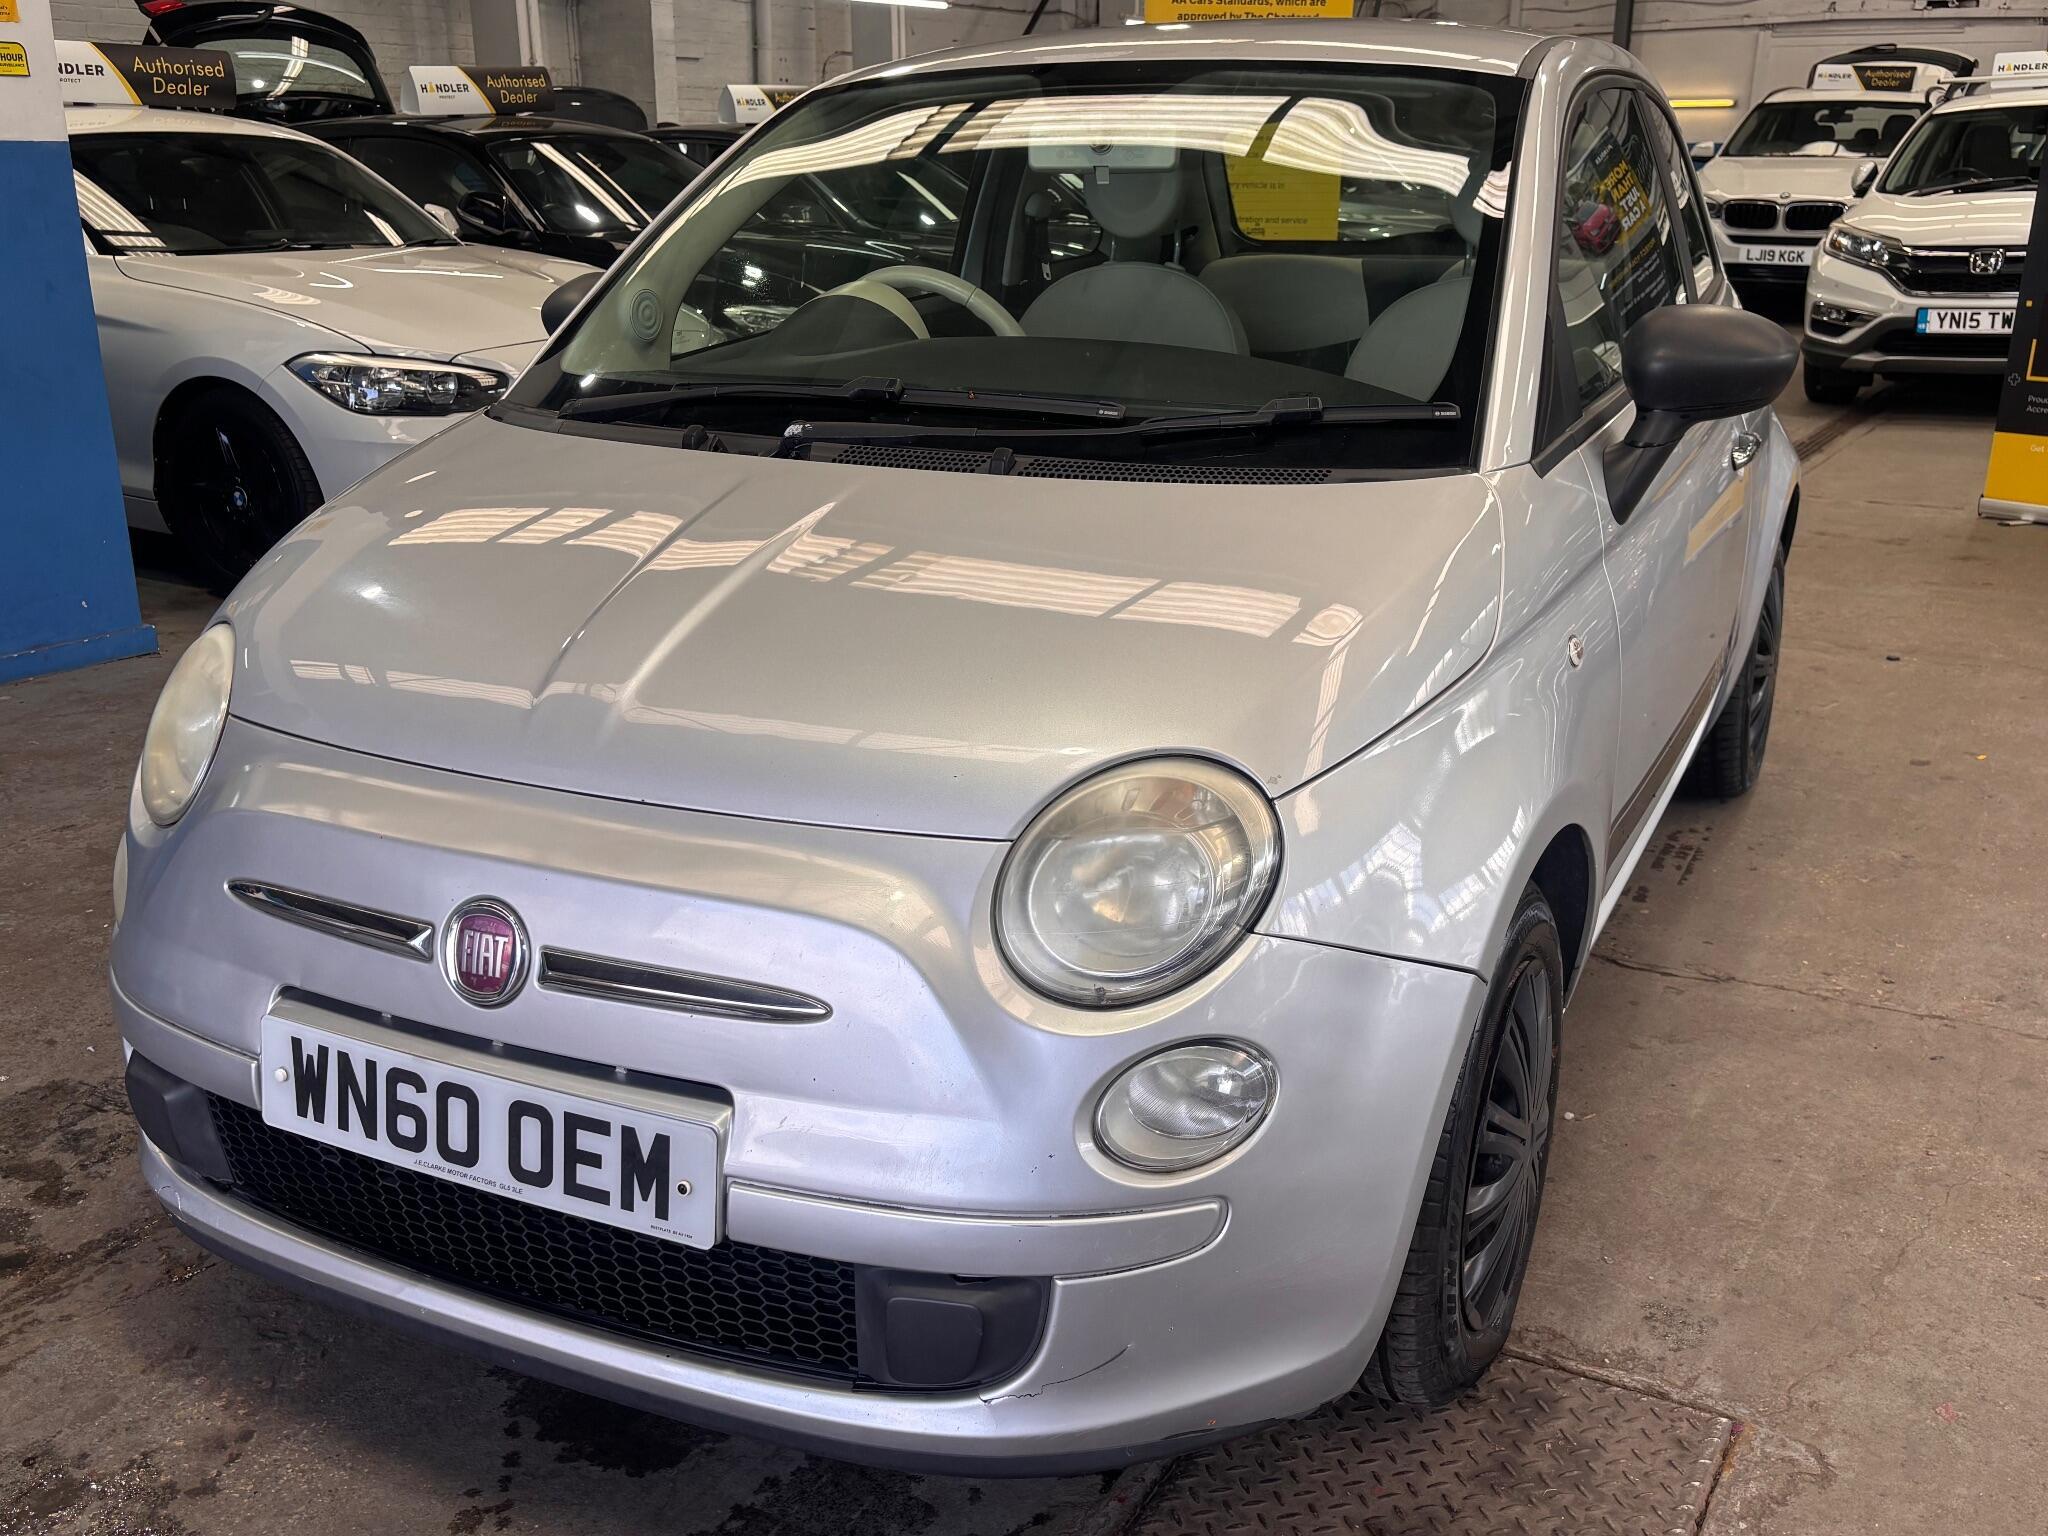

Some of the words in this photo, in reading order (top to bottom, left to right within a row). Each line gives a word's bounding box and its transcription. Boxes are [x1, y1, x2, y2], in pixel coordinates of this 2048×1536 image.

[0, 53, 24, 61] HOUR
[133, 56, 225, 78] Authorised
[1865, 69, 1912, 79] Authorised
[153, 77, 210, 96] Dealer
[486, 74, 546, 88] Authorised
[1871, 78, 1900, 87] Dealer
[501, 90, 538, 104] Dealer
[1746, 248, 1776, 262] LJ19
[1779, 250, 1805, 263] KGK
[1937, 312, 1981, 329] YN15
[1988, 312, 2014, 329] TW
[461, 929, 509, 979] FIAT
[291, 1036, 480, 1169] WN60
[508, 1099, 671, 1222] OEM
[414, 1159, 446, 1173] J.E.CLARKE
[446, 1168, 469, 1180] MOTOR
[468, 1174, 497, 1188] FACTORS
